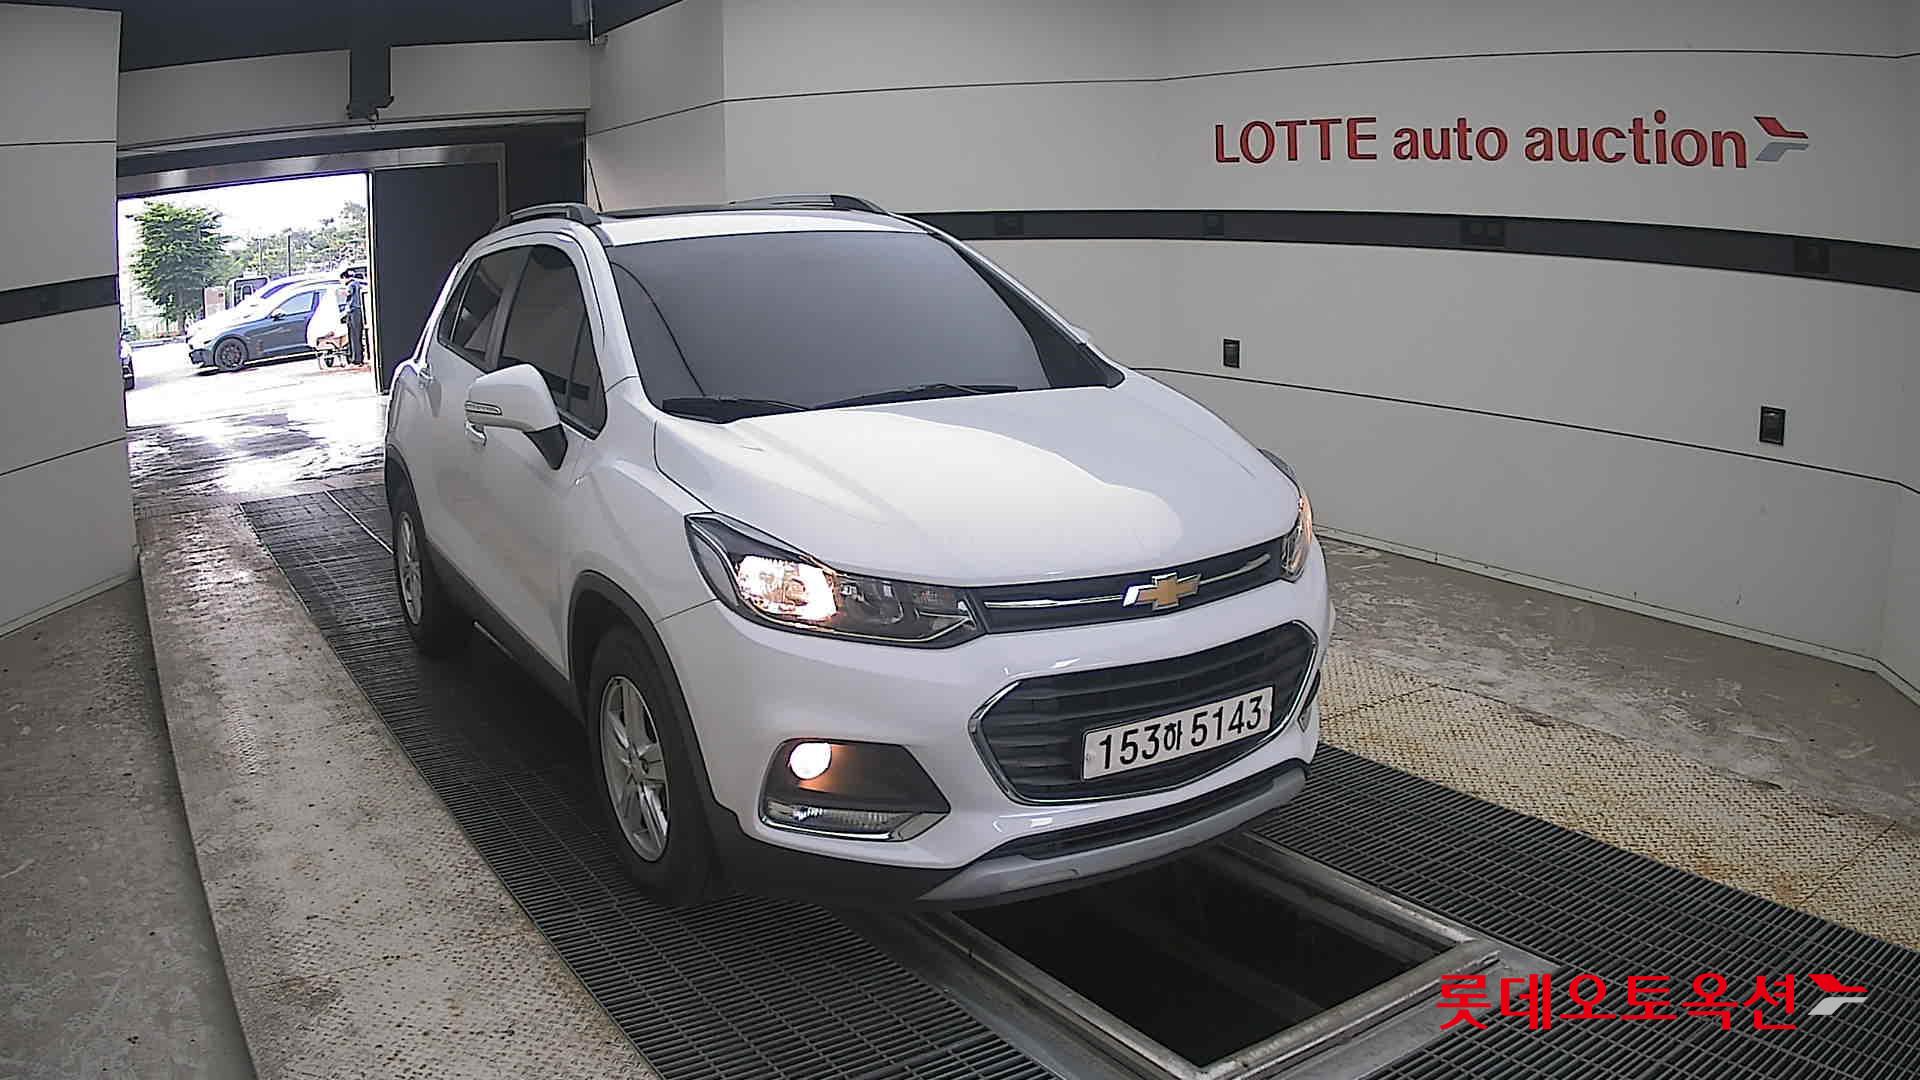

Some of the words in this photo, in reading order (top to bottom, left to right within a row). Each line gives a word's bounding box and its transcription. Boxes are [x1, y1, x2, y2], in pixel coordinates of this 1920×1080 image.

[1215, 117, 1377, 163] LOTTE
[1393, 117, 1508, 162] auto
[1524, 109, 1747, 168] auction
[1099, 720, 1182, 769] 153하
[1191, 696, 1263, 747] 5143
